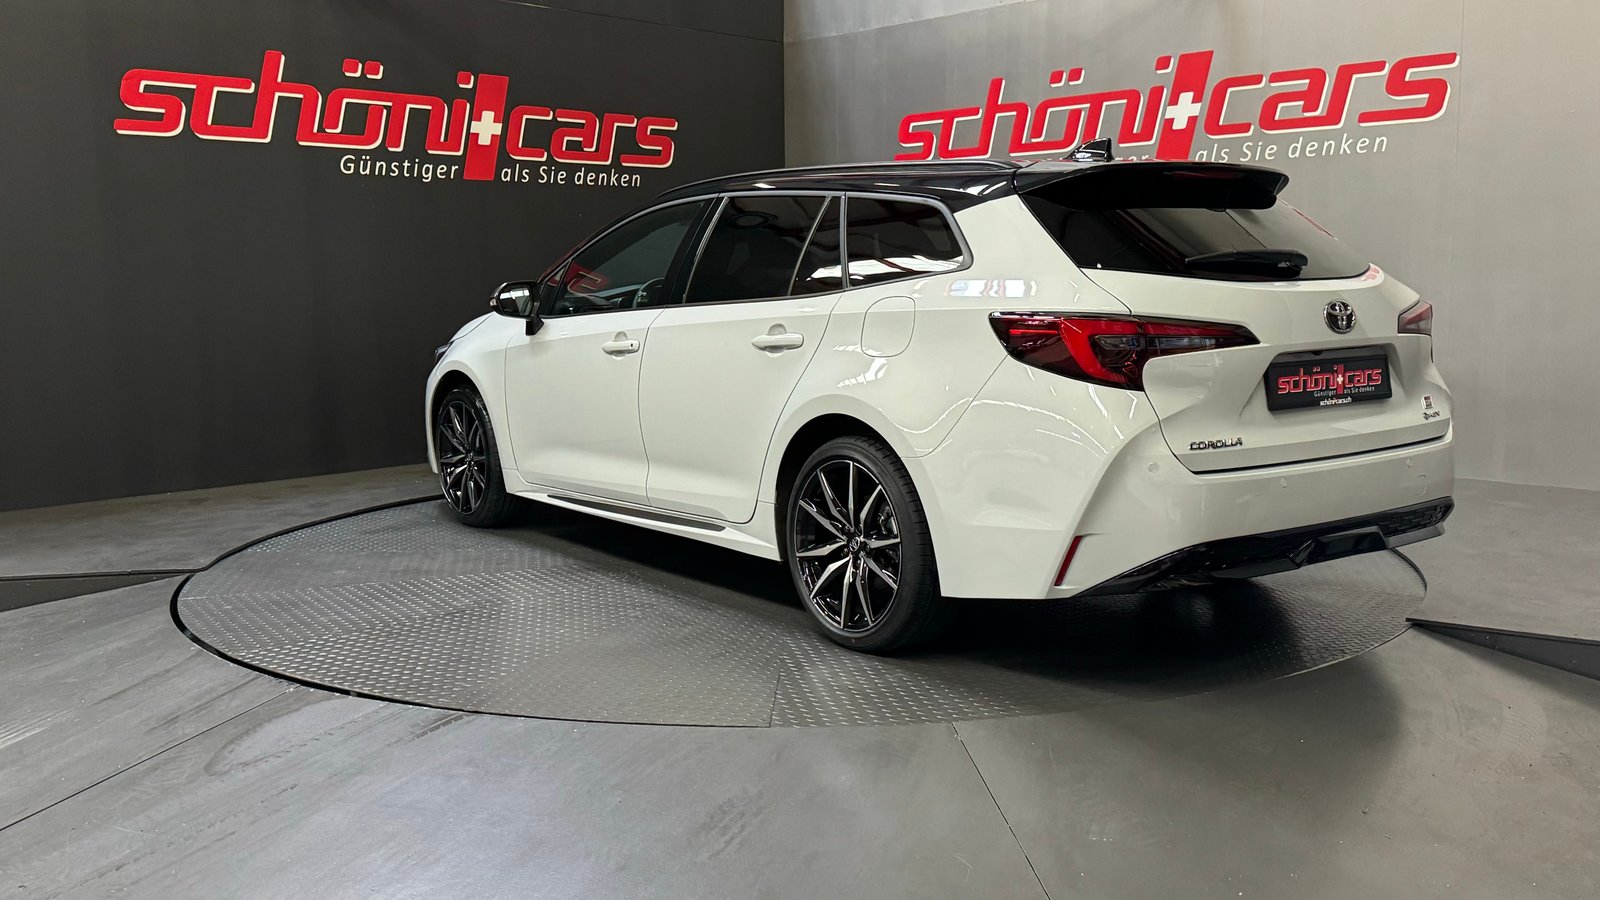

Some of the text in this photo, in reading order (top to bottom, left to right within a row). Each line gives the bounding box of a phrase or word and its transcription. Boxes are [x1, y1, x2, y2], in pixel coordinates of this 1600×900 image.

[1195, 134, 1388, 162] als Sie denken
[340, 155, 642, 187] Günstiger als Sie denken
[1189, 437, 1243, 450] COROLLA
